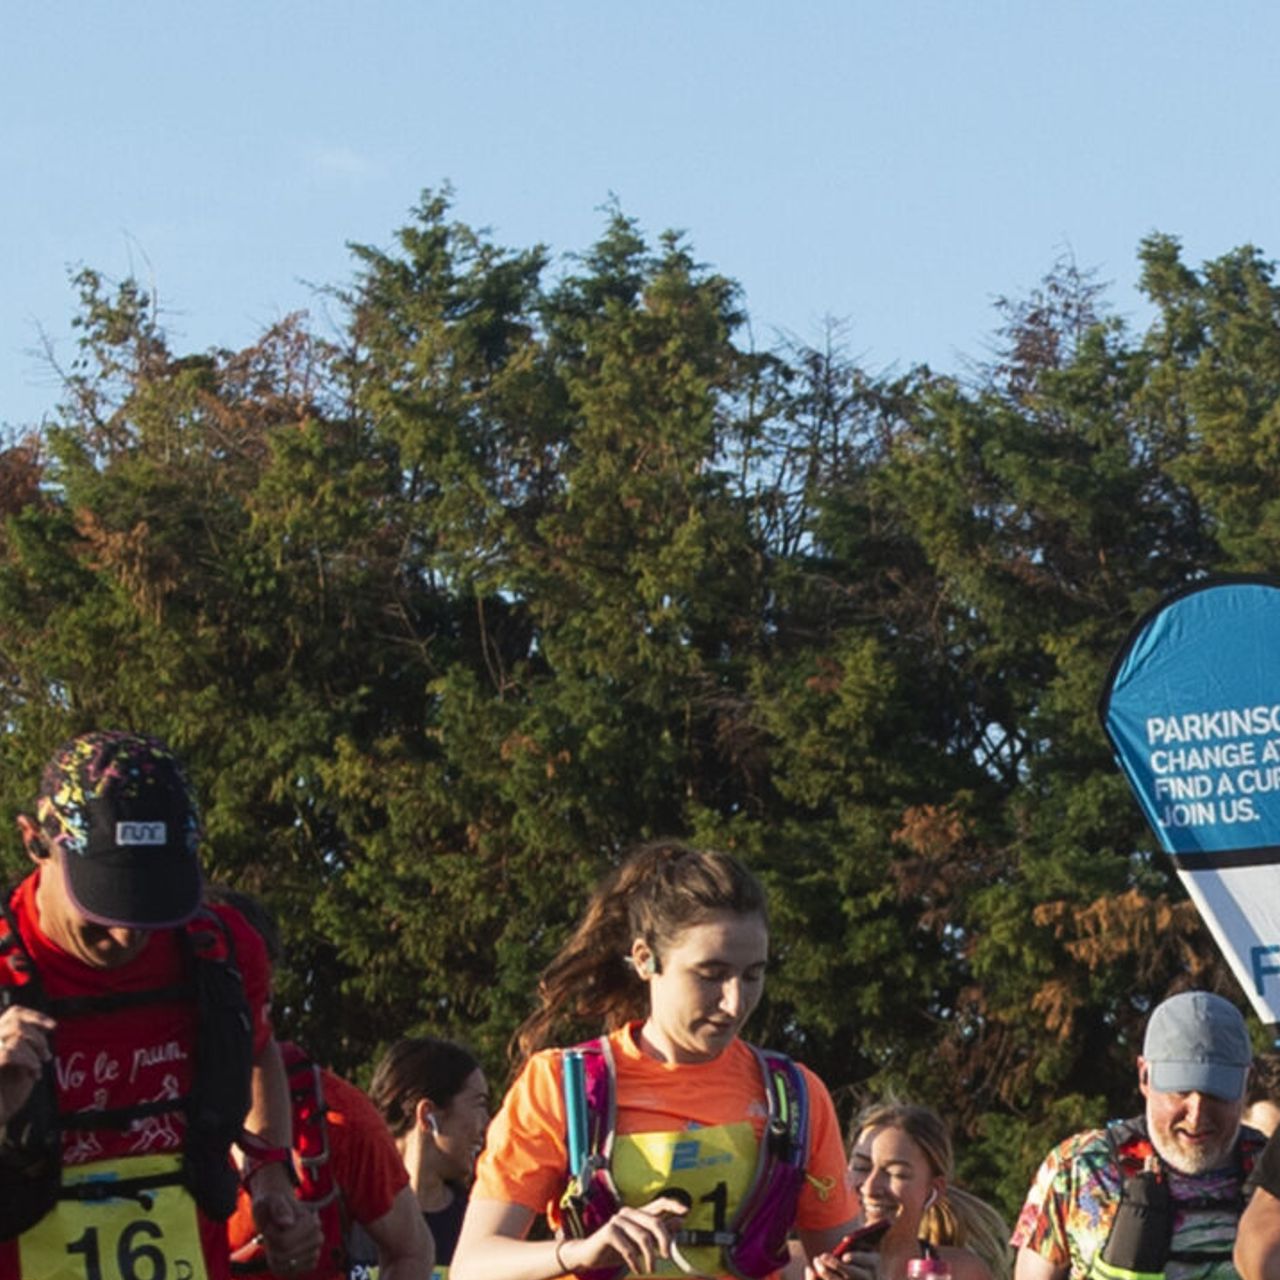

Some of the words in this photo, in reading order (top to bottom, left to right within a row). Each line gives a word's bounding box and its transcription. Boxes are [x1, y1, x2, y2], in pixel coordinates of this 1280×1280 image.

[1150, 743, 1256, 775] CHANGE
[1155, 774, 1213, 801] FIND
[1216, 772, 1236, 797] A
[1159, 802, 1216, 828] JOIN
[1219, 798, 1261, 825] US.
